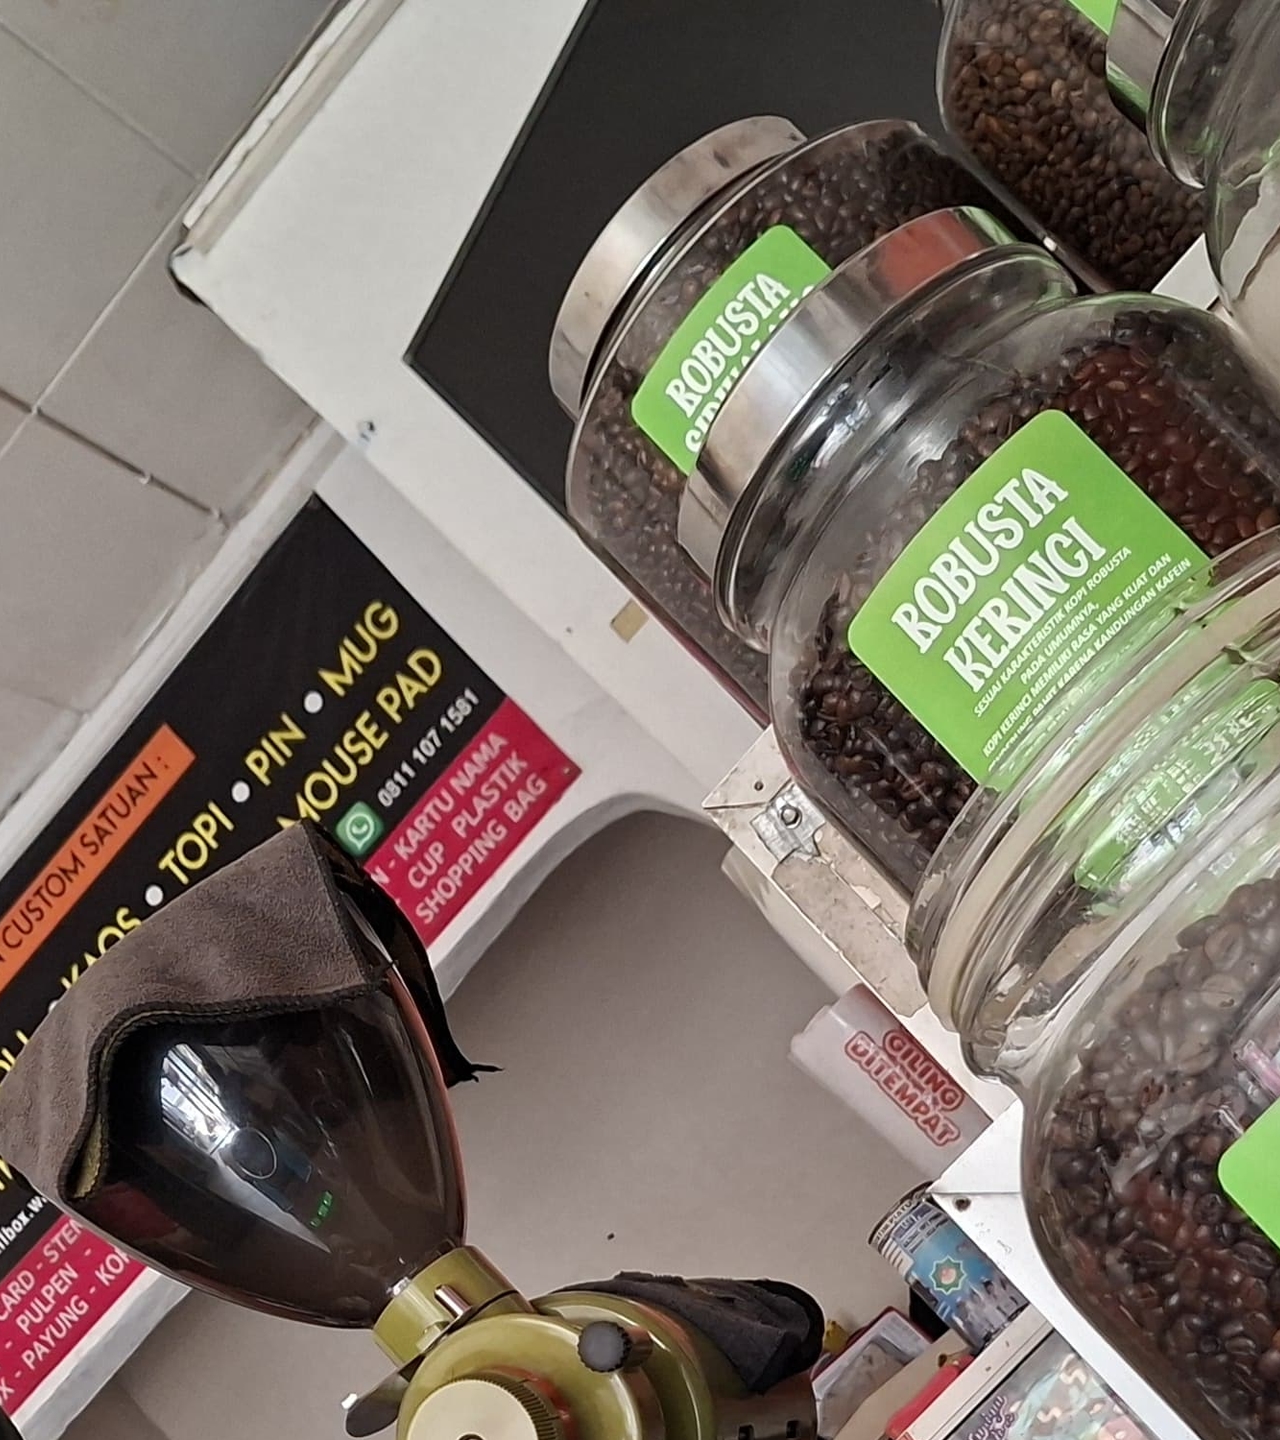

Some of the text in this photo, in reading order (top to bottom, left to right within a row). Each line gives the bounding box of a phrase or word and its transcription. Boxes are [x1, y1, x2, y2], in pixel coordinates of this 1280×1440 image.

[666, 274, 790, 416] ROBUSTA
[892, 469, 1067, 652] ROBUSTA
[1093, 587, 1157, 651] KANDUNGAN
[1154, 558, 1191, 592] KAFEIN
[376, 649, 442, 723] PAD
[974, 679, 1003, 718] SESUAI
[1000, 608, 1066, 684] KARAKTERISTIK
[1063, 586, 1088, 614] KOPI
[1086, 547, 1132, 591] ROBUSTA
[982, 730, 1006, 758] KOPI
[1030, 647, 1073, 697] MEMILIKI
[1070, 623, 1098, 652] RASA
[1095, 596, 1124, 625] YANG
[1122, 571, 1148, 600] KUAT
[1147, 553, 1172, 577] DAN
[1020, 602, 1099, 685] PADA UMUMNYA,
[158, 802, 234, 884] TOPI
[245, 714, 305, 785] PIN
[319, 602, 399, 696] MUG
[377, 688, 479, 807] 0811 107 1581
[393, 789, 455, 861] KARTU
[449, 733, 507, 796] NAMA
[1, 851, 86, 949] CUSTOM
[79, 762, 158, 856] SATUAN
[408, 752, 527, 889] CUP PLASTIK
[415, 774, 547, 924] SHOPPING BAG
[845, 1042, 960, 1146] DITEMPAT
[882, 1029, 963, 1106] GILING
[16, 1263, 79, 1335] PULPEN
[21, 1295, 89, 1370] PAYUNG
